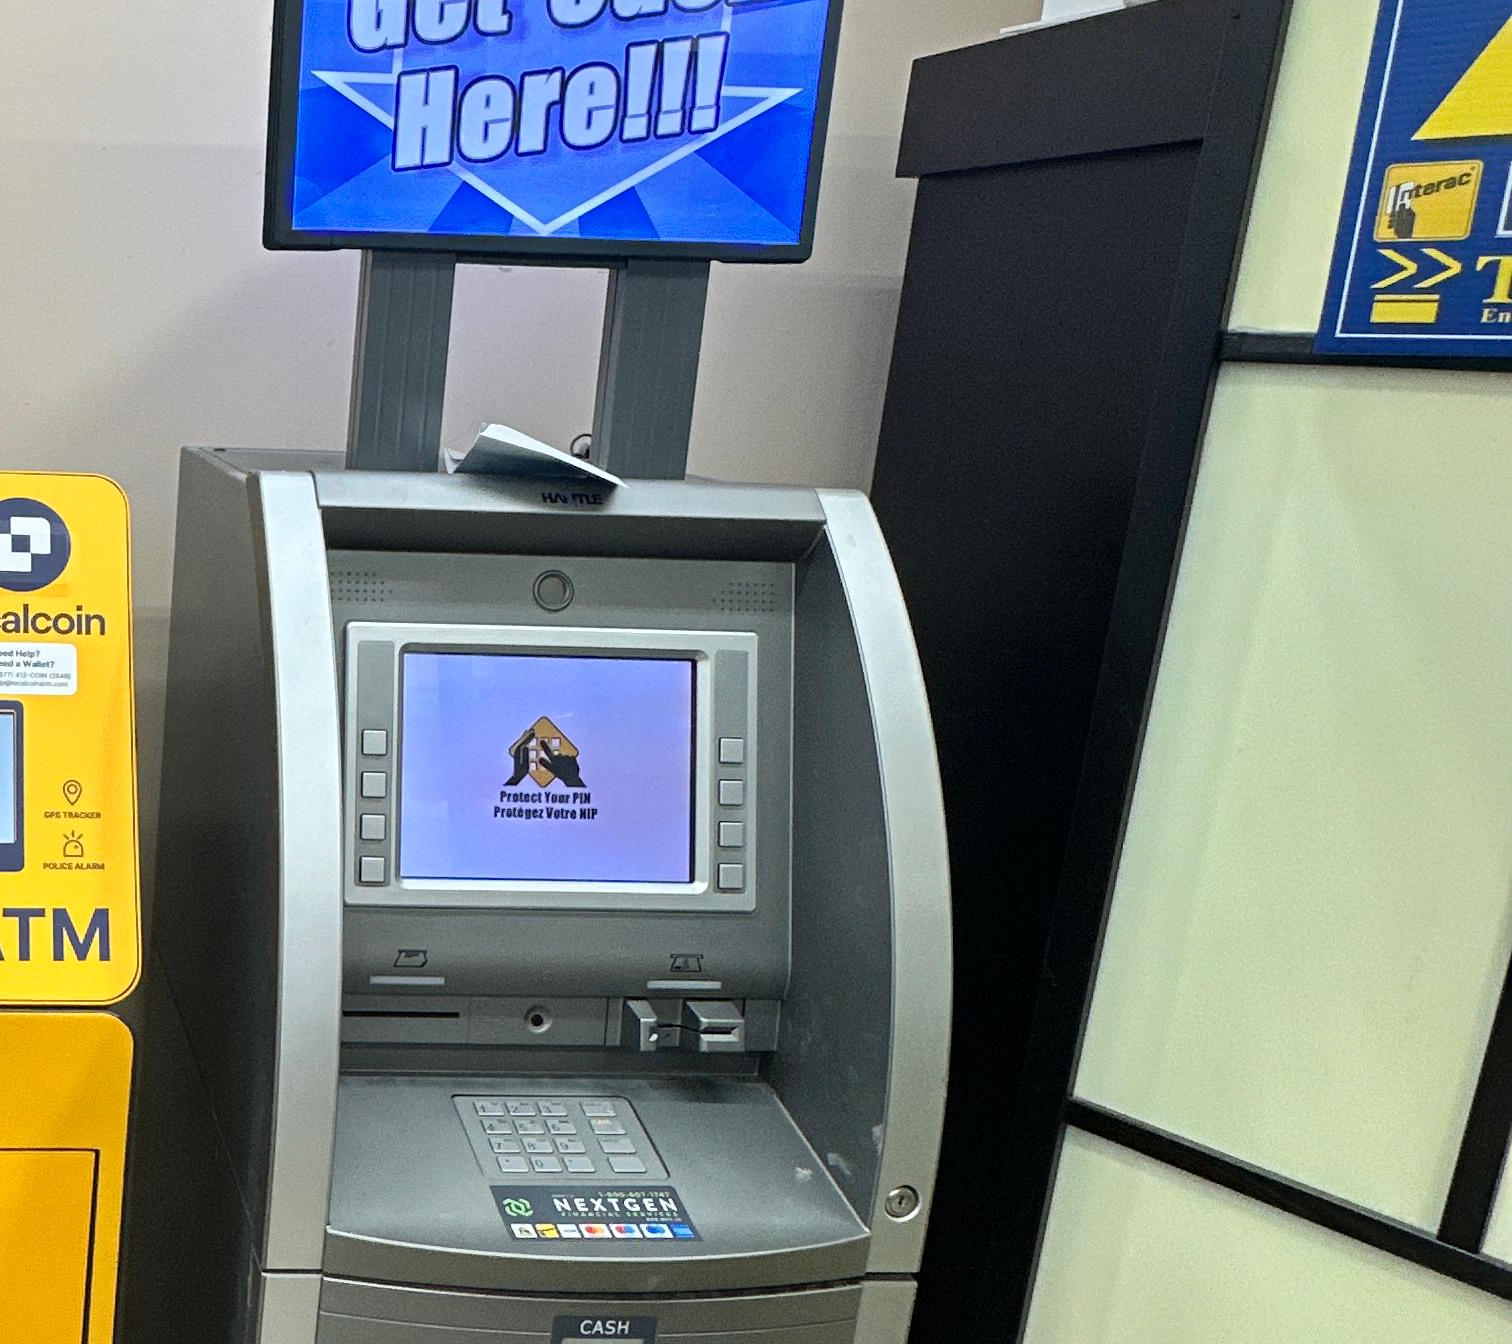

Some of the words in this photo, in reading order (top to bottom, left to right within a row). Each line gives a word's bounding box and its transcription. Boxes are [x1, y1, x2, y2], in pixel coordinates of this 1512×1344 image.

[394, 34, 728, 170] Here!!!
[15, 650, 40, 660] Help?
[23, 660, 55, 669] Wallet?
[500, 791, 542, 803] Protect
[544, 792, 570, 803] Your
[572, 792, 591, 804] PIN
[494, 806, 544, 820] Protégez
[545, 807, 577, 819] Votre
[579, 808, 598, 820] NIP
[552, 1197, 678, 1212] NEXTGEN
[580, 1320, 630, 1336] CASH
